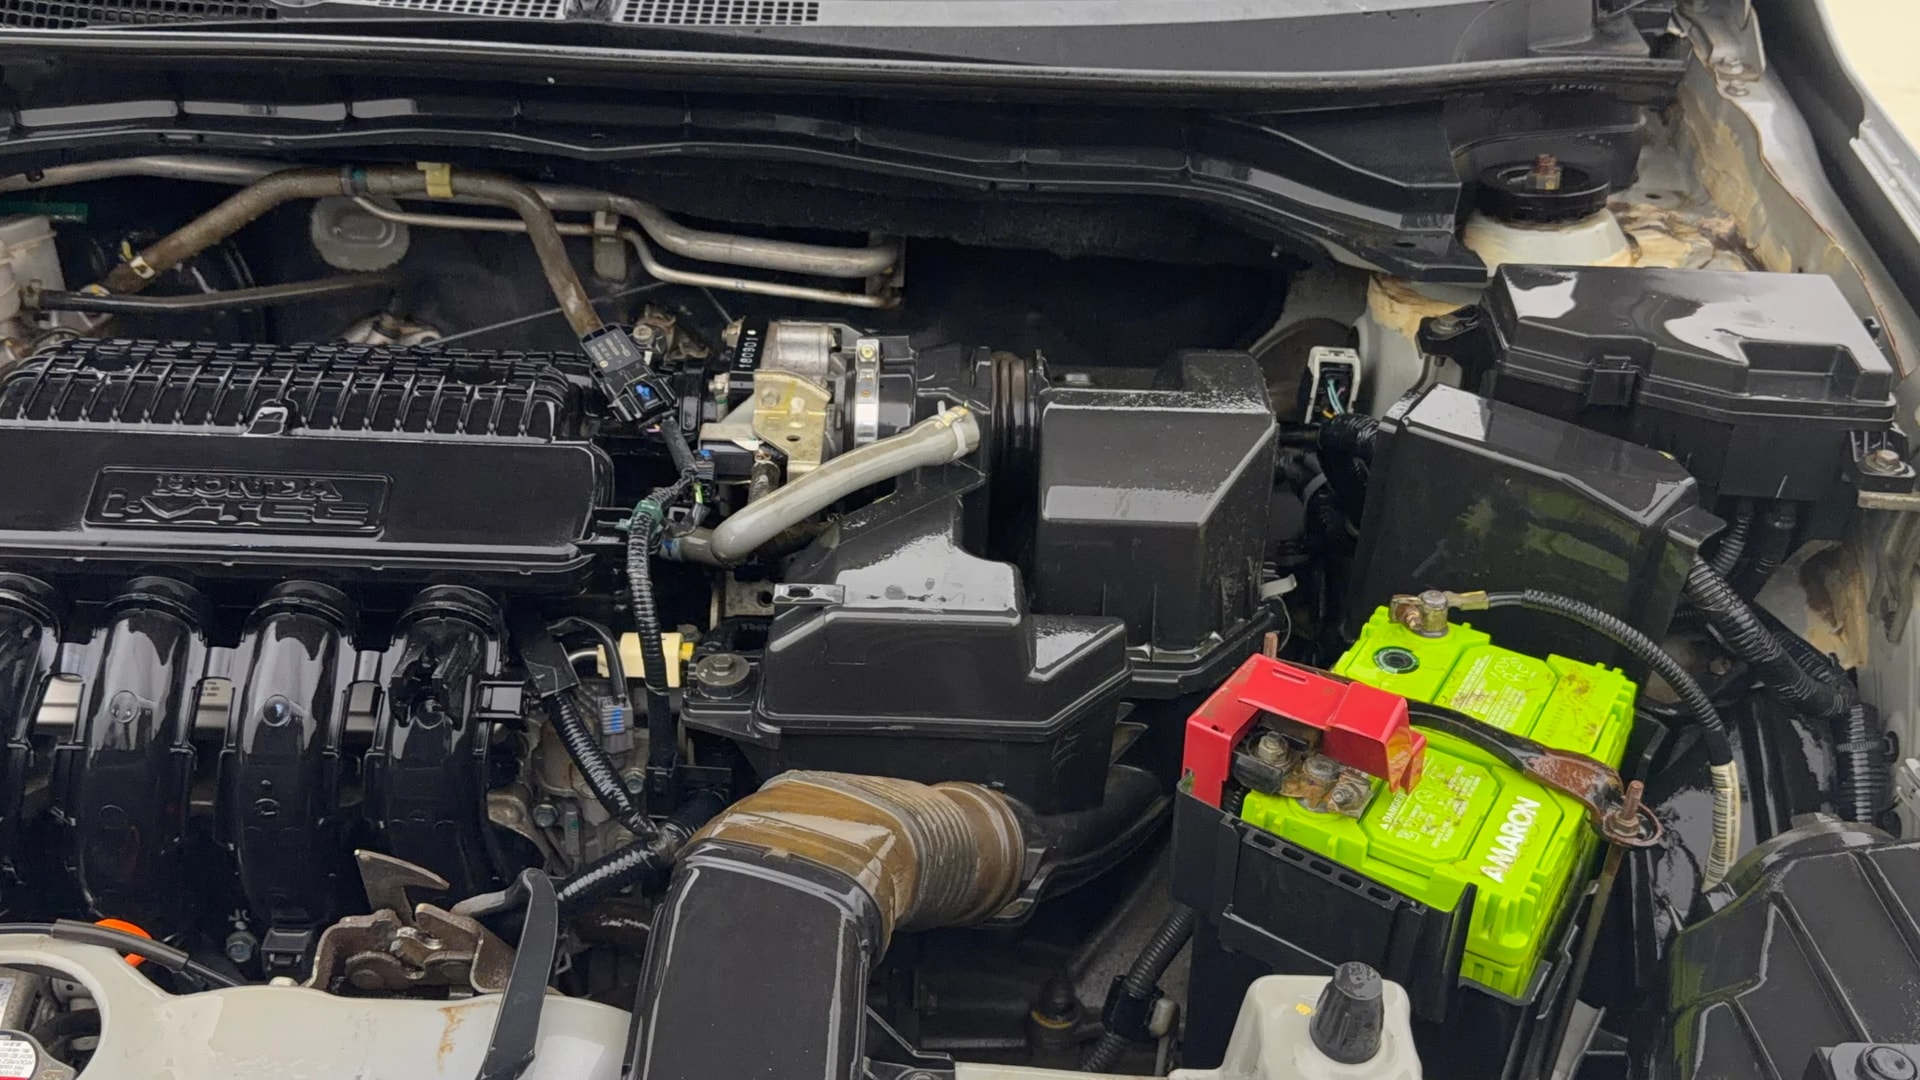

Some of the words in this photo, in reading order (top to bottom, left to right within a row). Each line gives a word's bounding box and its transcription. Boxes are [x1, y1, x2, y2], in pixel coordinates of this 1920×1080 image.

[739, 336, 758, 368] 180901
[152, 474, 343, 502] HONDA
[1383, 792, 1408, 825] DANGER
[1480, 796, 1542, 884] AMARON
